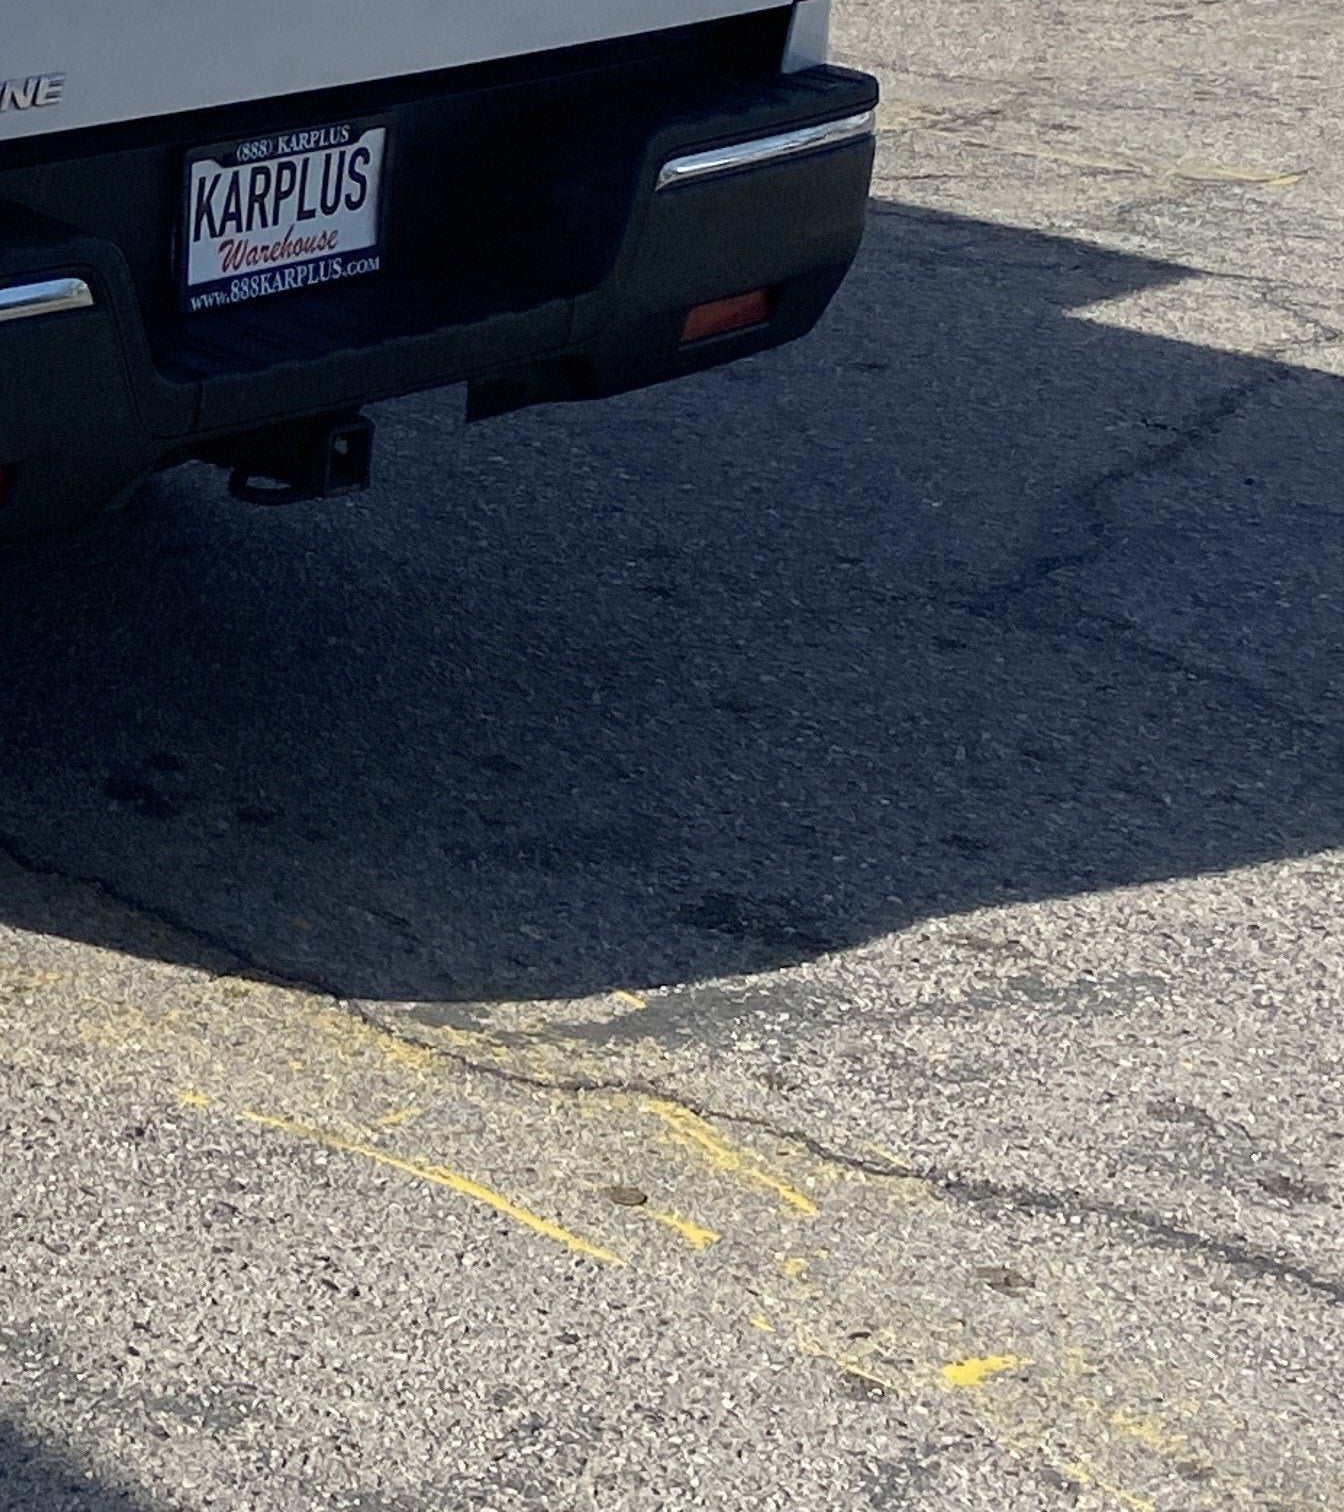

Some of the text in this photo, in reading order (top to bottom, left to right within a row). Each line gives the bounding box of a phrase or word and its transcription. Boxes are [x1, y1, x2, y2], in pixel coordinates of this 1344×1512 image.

[236, 124, 351, 162] (888) KARPLUS
[193, 146, 371, 243] KARPLUS
[218, 223, 339, 273] Warehouse
